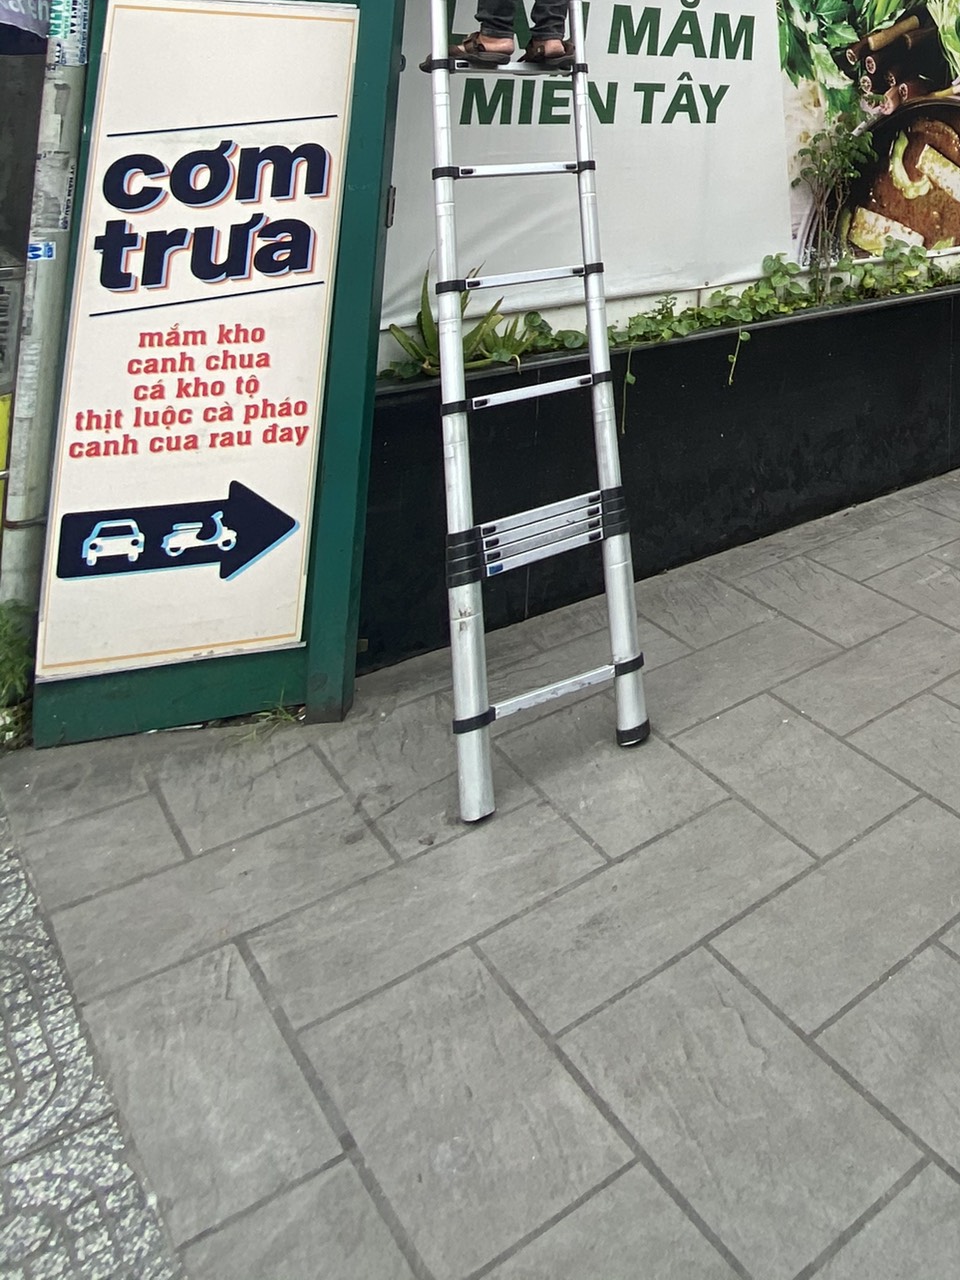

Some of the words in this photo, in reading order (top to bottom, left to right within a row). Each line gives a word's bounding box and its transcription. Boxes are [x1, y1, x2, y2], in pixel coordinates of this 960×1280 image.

[633, 71, 731, 124] TÂY
[102, 139, 335, 215] cơm
[93, 212, 319, 295] trưa
[138, 323, 208, 348] mắm
[217, 323, 266, 345] kho
[127, 352, 196, 375] canh
[205, 350, 271, 371] chua
[133, 379, 166, 401] cá
[175, 377, 226, 399] kho
[235, 375, 261, 398] tộ
[75, 409, 124, 434] thịt
[133, 405, 193, 430] luộc
[203, 401, 233, 423] cà
[243, 397, 309, 425] pháo
[68, 434, 139, 459] canh
[149, 434, 200, 454] cua
[208, 430, 252, 449] rau
[262, 423, 310, 447] đay
